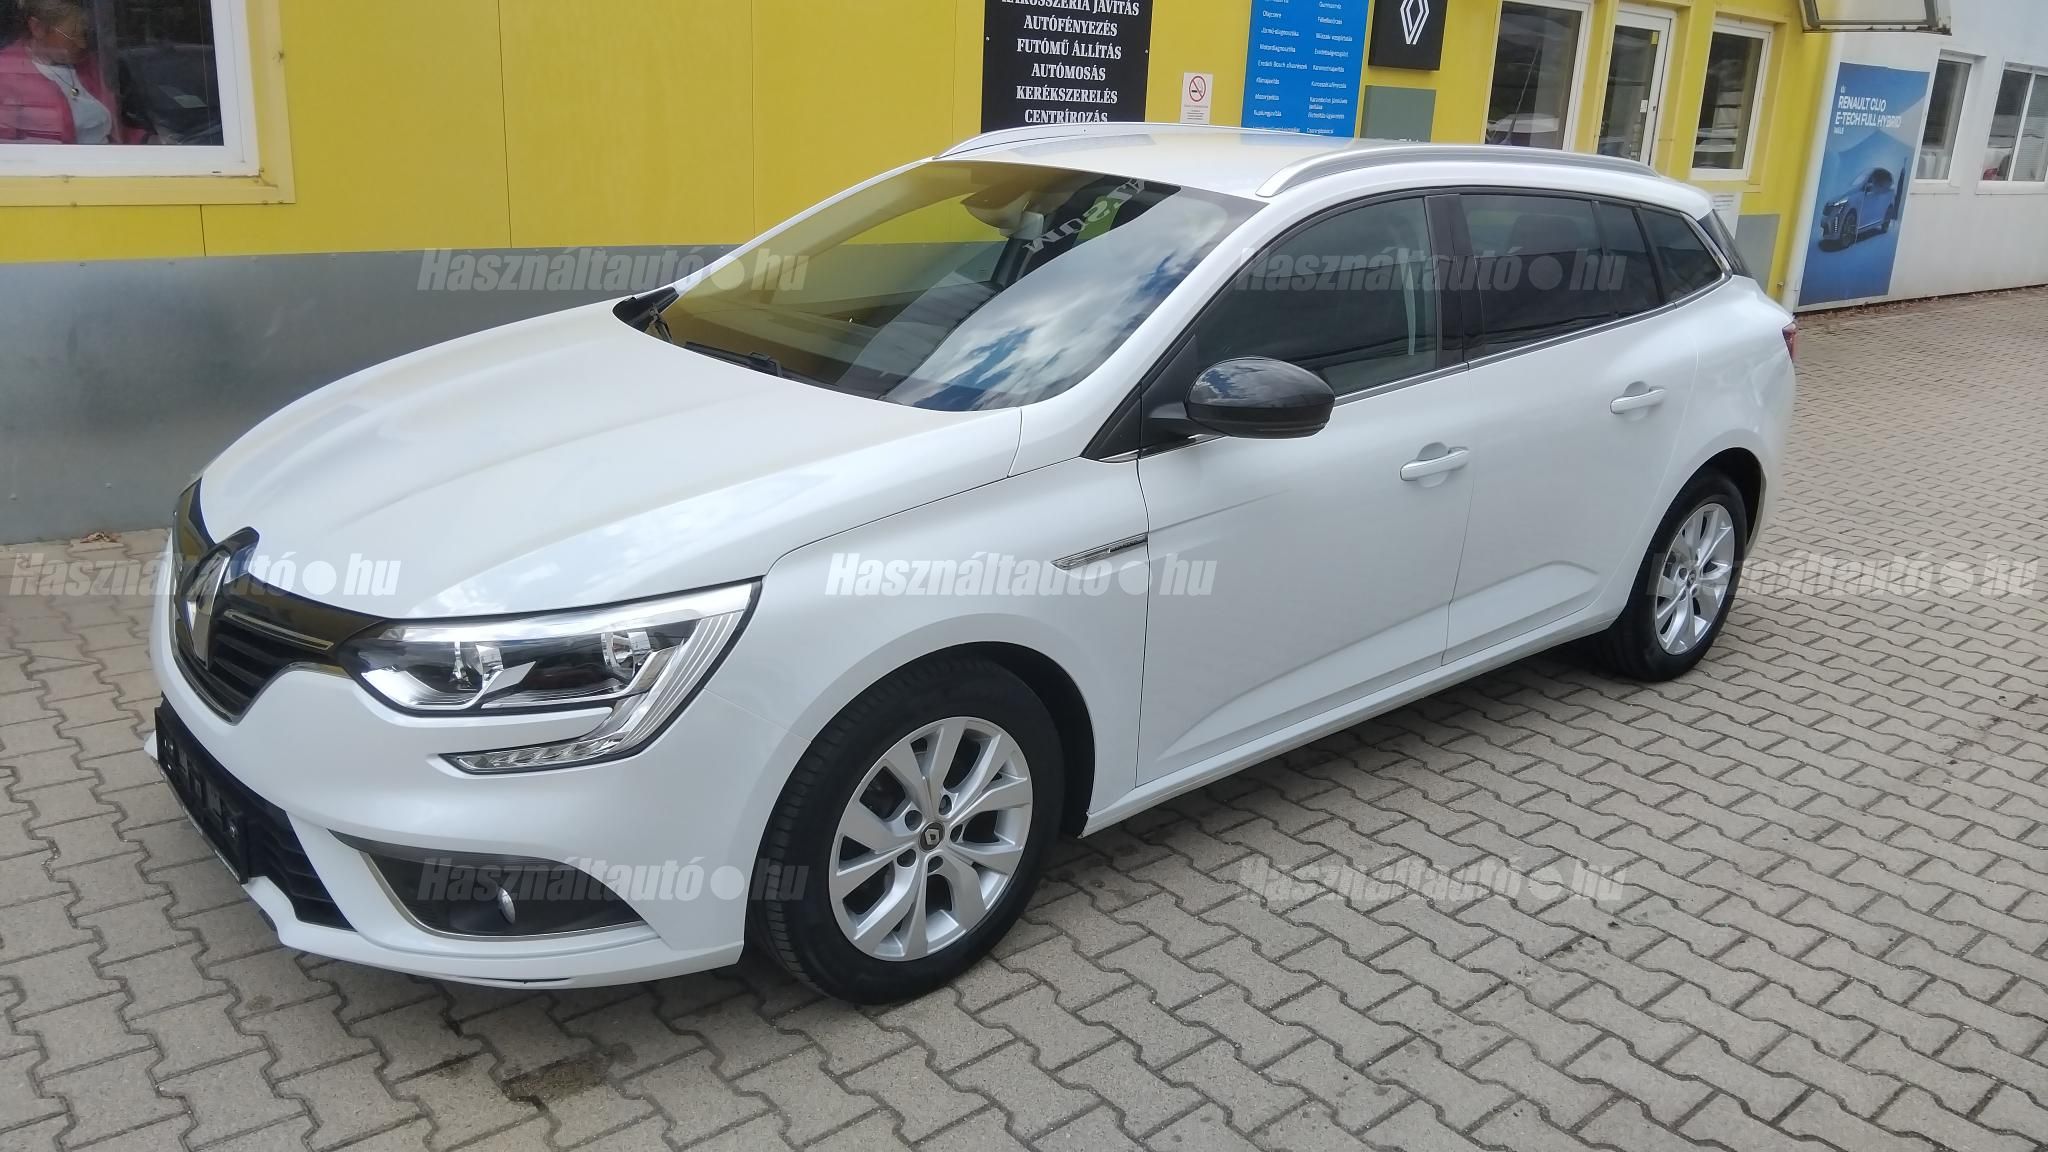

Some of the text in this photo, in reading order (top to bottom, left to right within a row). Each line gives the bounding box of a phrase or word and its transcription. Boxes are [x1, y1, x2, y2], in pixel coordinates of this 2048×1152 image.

[1023, 15, 1118, 37] AUTÓFÉNYEZÉS
[1016, 38, 1122, 60] FUTÓMŰ ÁLLÍTÁS
[1031, 62, 1106, 81] AUTÓMOSÁS
[1015, 84, 1118, 104] KERÉKSZERELÉS
[1838, 95, 1887, 112] RENAULT CLIO
[1024, 108, 1108, 123] CENTRÍROZÁS
[1834, 111, 1861, 126] E-TECH
[1861, 112, 1876, 127] FULL
